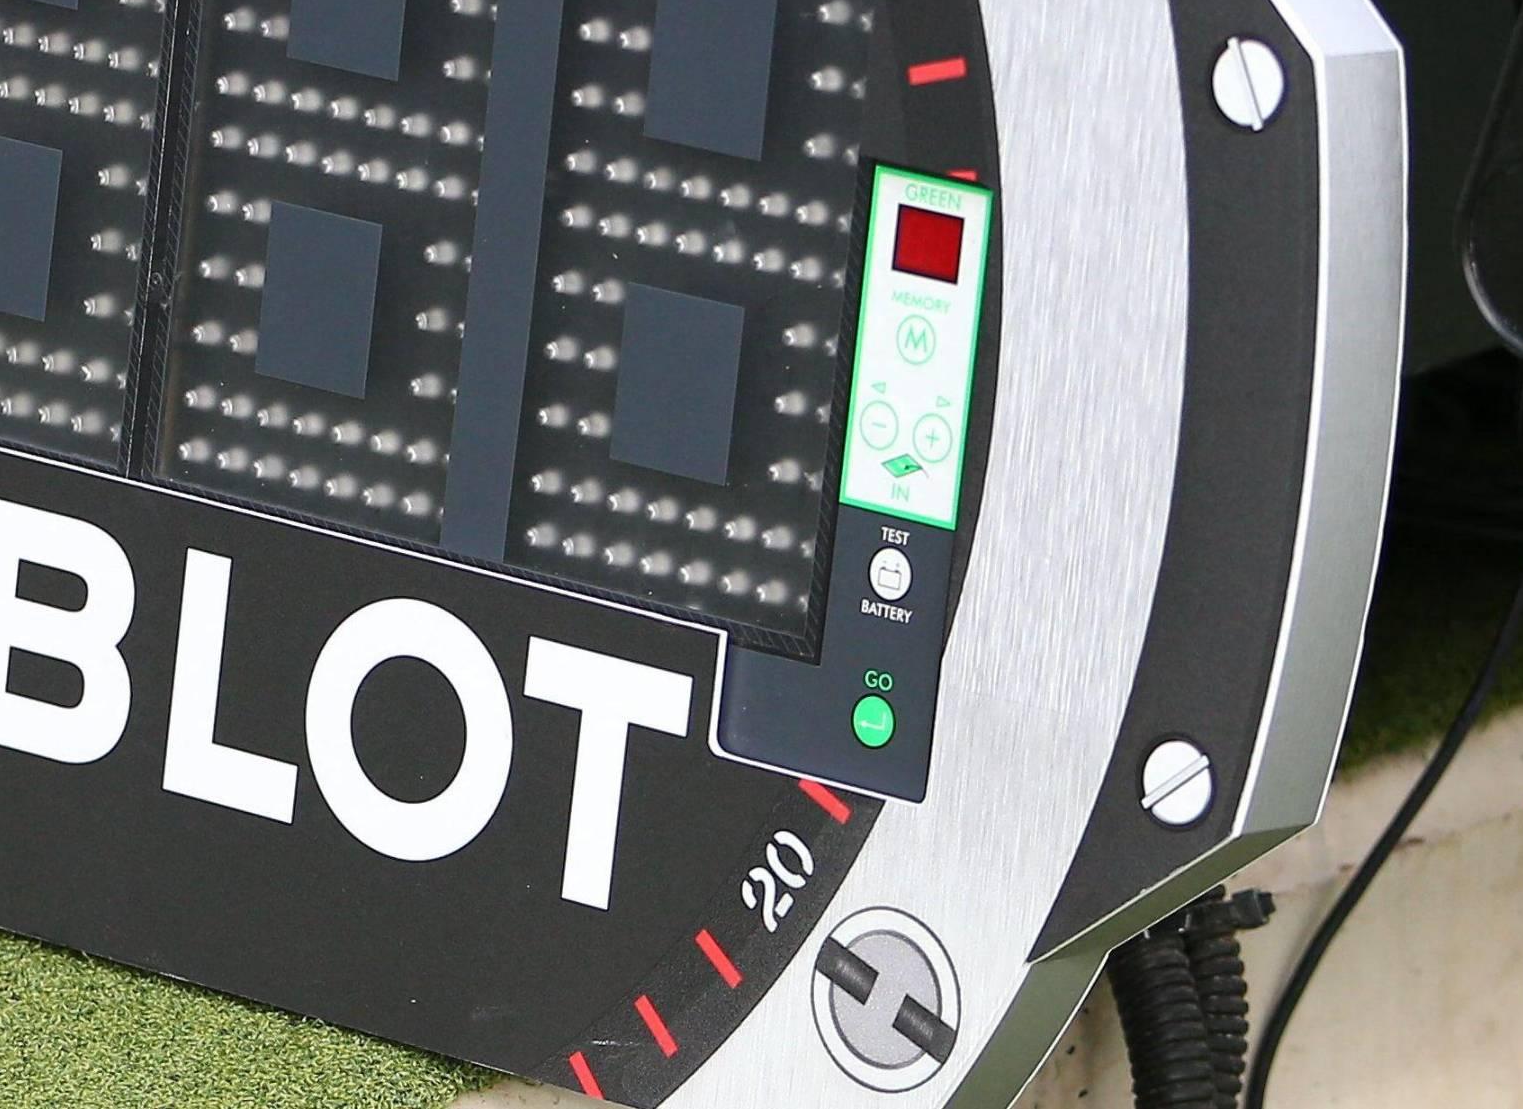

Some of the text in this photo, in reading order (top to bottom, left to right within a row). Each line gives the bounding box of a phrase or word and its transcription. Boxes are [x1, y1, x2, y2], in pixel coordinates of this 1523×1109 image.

[905, 182, 963, 210] GREEN
[891, 289, 953, 314] MEMORY
[905, 323, 928, 353] M
[890, 482, 910, 503] IN
[881, 526, 911, 547] TEST
[861, 598, 914, 624] BATTERY
[864, 669, 894, 692] GO
[742, 830, 814, 933] 20
